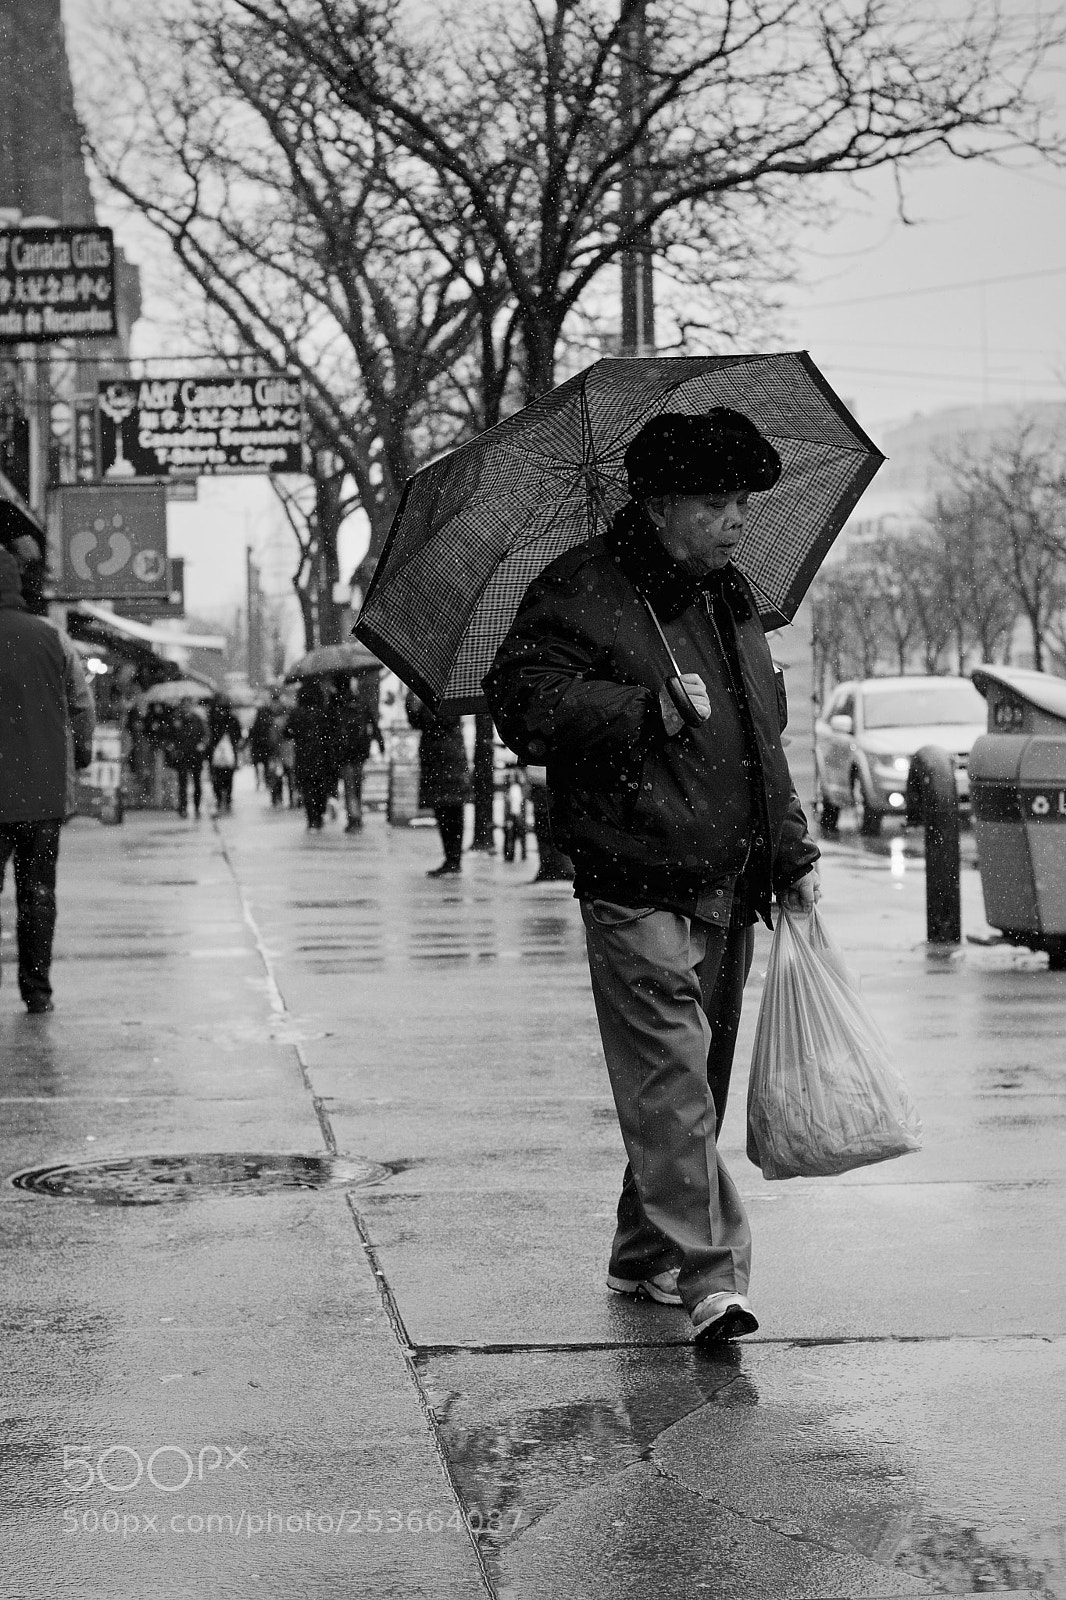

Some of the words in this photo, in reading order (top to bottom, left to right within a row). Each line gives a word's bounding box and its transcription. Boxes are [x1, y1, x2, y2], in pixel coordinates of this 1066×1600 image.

[11, 235, 71, 270] Canada
[72, 232, 111, 268] Gifts
[181, 380, 252, 405] Canada
[254, 379, 300, 405] Gifts
[138, 429, 216, 447] Canadian
[219, 427, 300, 446] Souvenirs
[153, 448, 226, 465] T-Shirts
[240, 447, 287, 463] Caps
